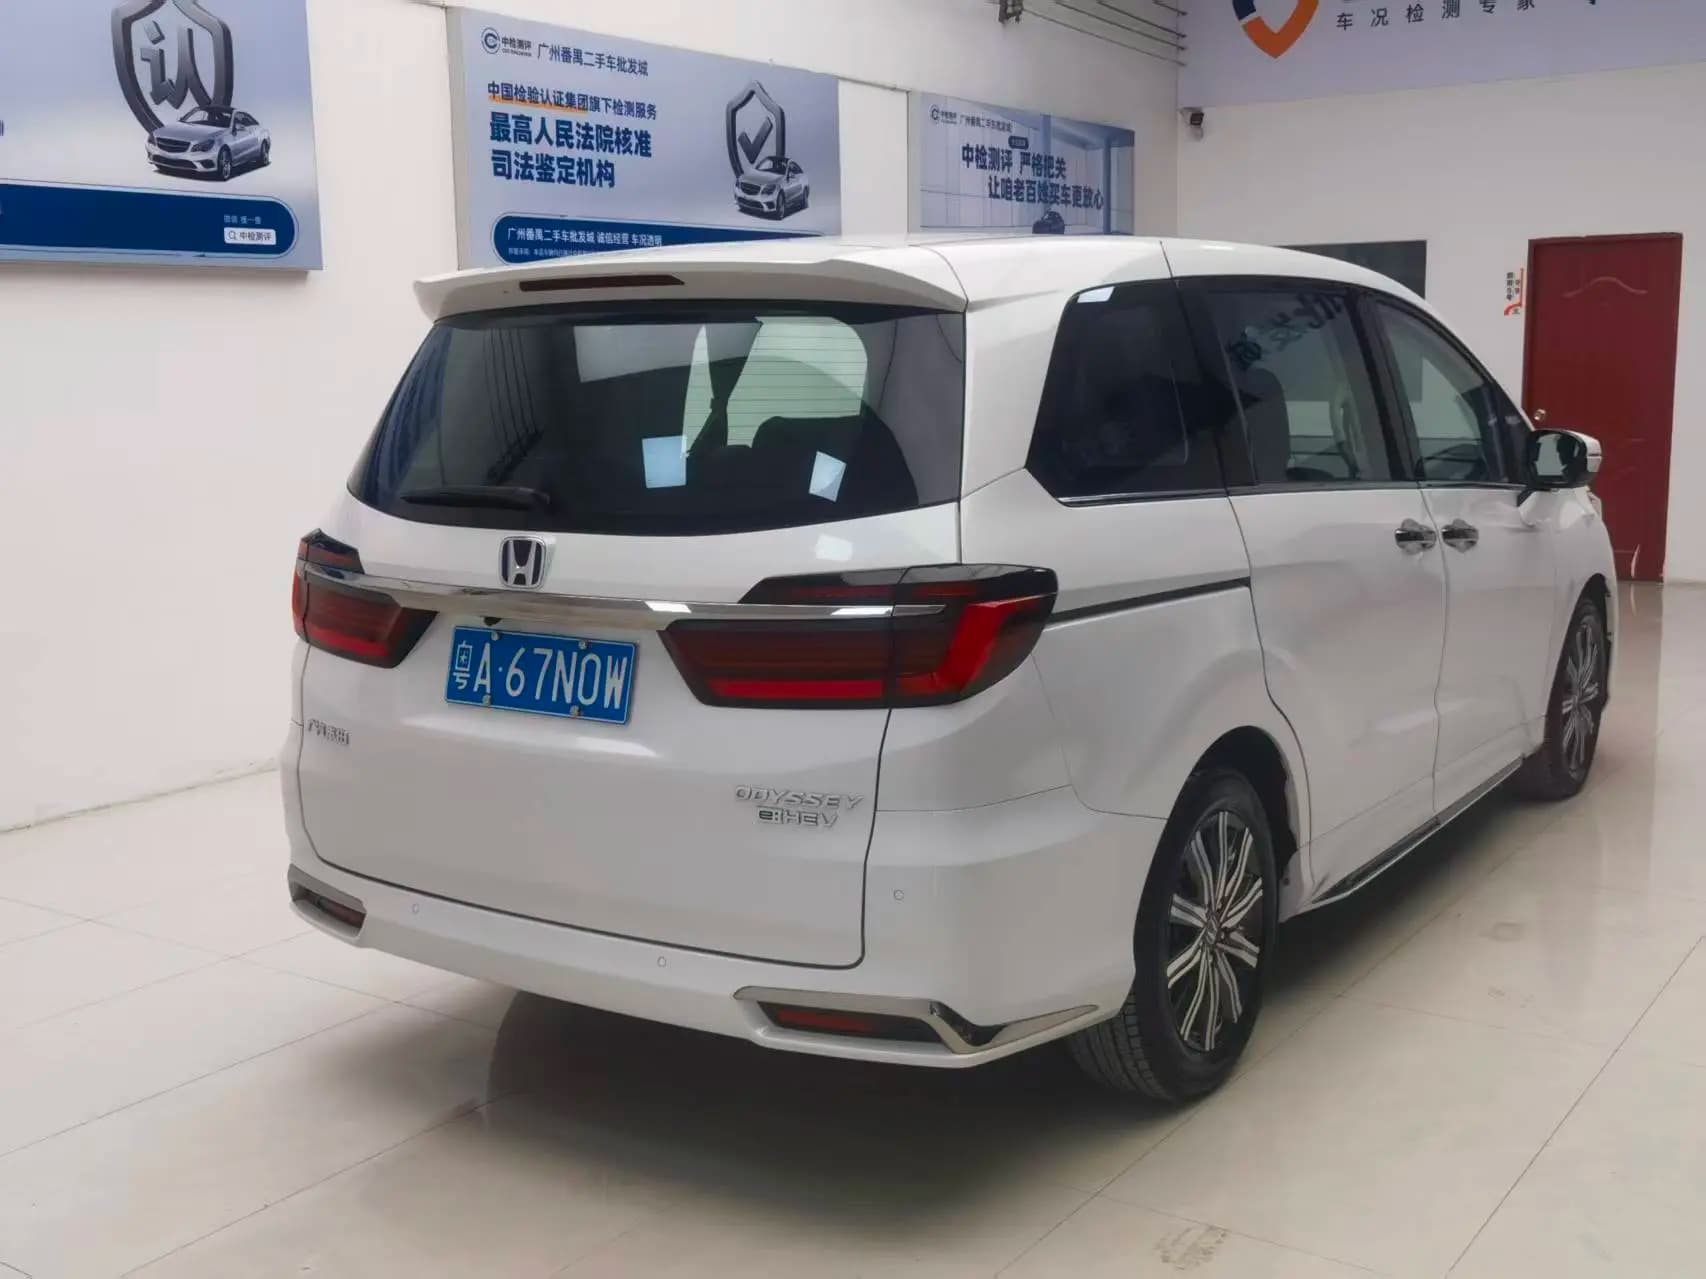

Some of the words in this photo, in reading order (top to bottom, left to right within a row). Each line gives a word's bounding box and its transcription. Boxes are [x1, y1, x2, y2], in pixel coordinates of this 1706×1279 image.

[536, 42, 649, 77] 广州番禺二手车批发城
[487, 80, 657, 121] 中国检验认证集团旗下检测服务
[489, 111, 653, 158] 最高人民法院核准
[491, 149, 615, 189] 司法鉴定机构
[961, 143, 1013, 174] 中检测评
[1019, 151, 1067, 180] 严格把关
[988, 175, 1105, 211] 让咱老百姓买车更放心
[507, 227, 596, 244] 广州番禺二手车批发城
[735, 784, 864, 810] ODYSSEY
